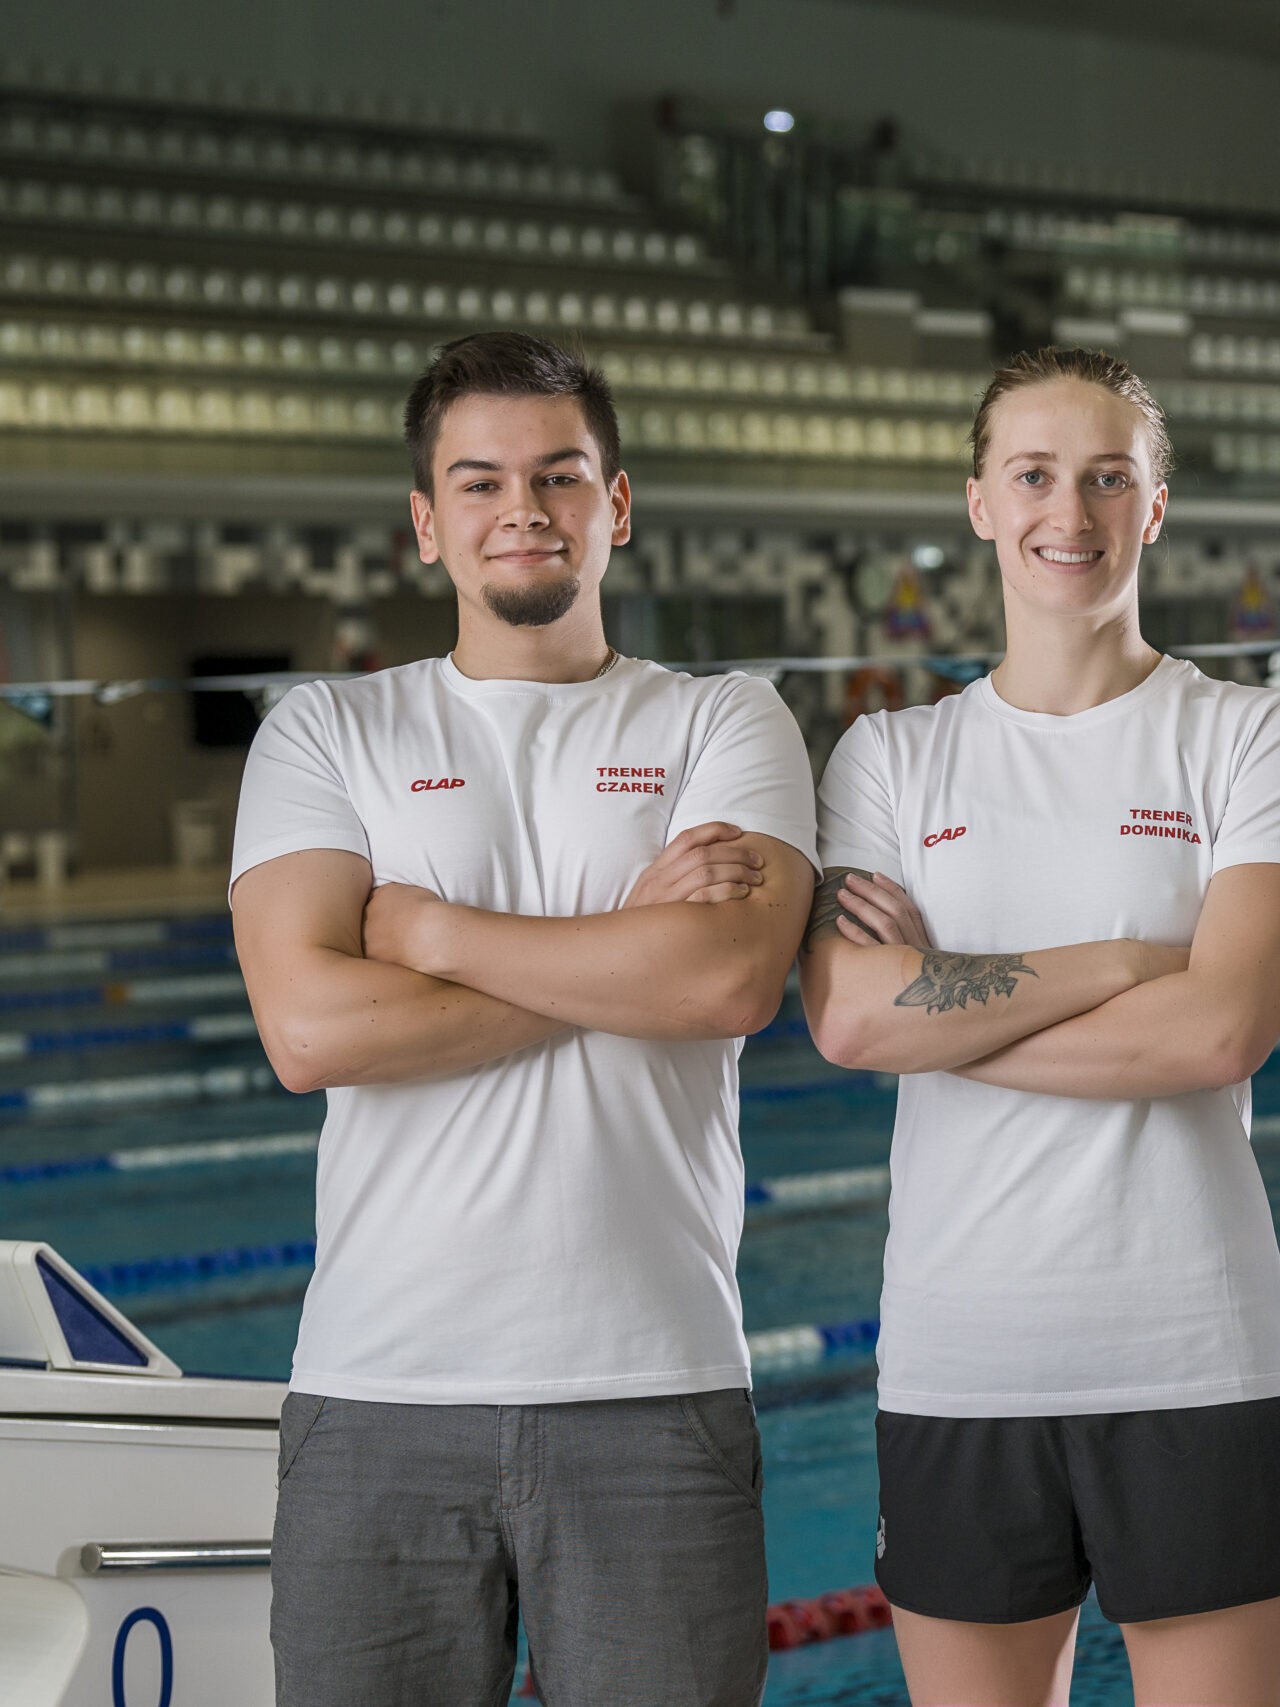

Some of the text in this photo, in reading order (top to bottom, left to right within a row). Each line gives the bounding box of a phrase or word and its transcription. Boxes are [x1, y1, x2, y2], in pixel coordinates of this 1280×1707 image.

[596, 767, 666, 778] TRENER
[410, 778, 466, 793] CLAP
[595, 781, 665, 796] CZAREK
[1129, 808, 1193, 827] TRENER
[1119, 824, 1202, 845] DOMINIKA
